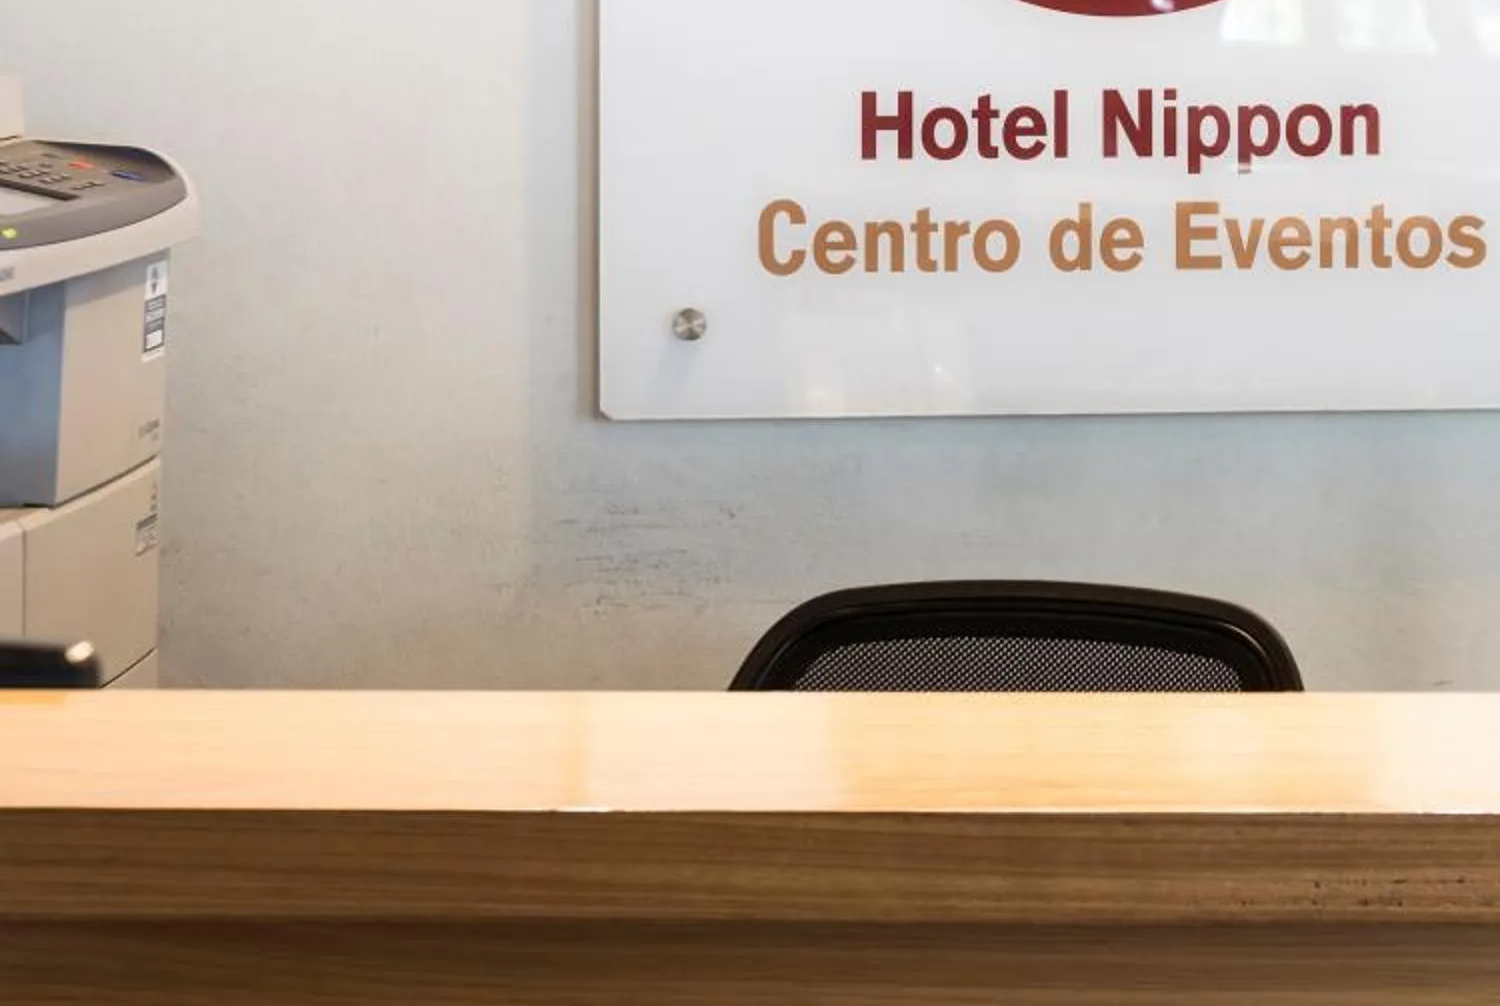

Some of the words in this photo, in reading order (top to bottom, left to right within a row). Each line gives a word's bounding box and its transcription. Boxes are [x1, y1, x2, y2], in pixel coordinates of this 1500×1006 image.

[860, 89, 1069, 160] Hotel
[1102, 88, 1382, 174] Nippon
[757, 199, 1021, 276] Centro
[1048, 203, 1144, 272] de
[1174, 201, 1486, 271] Eventos
